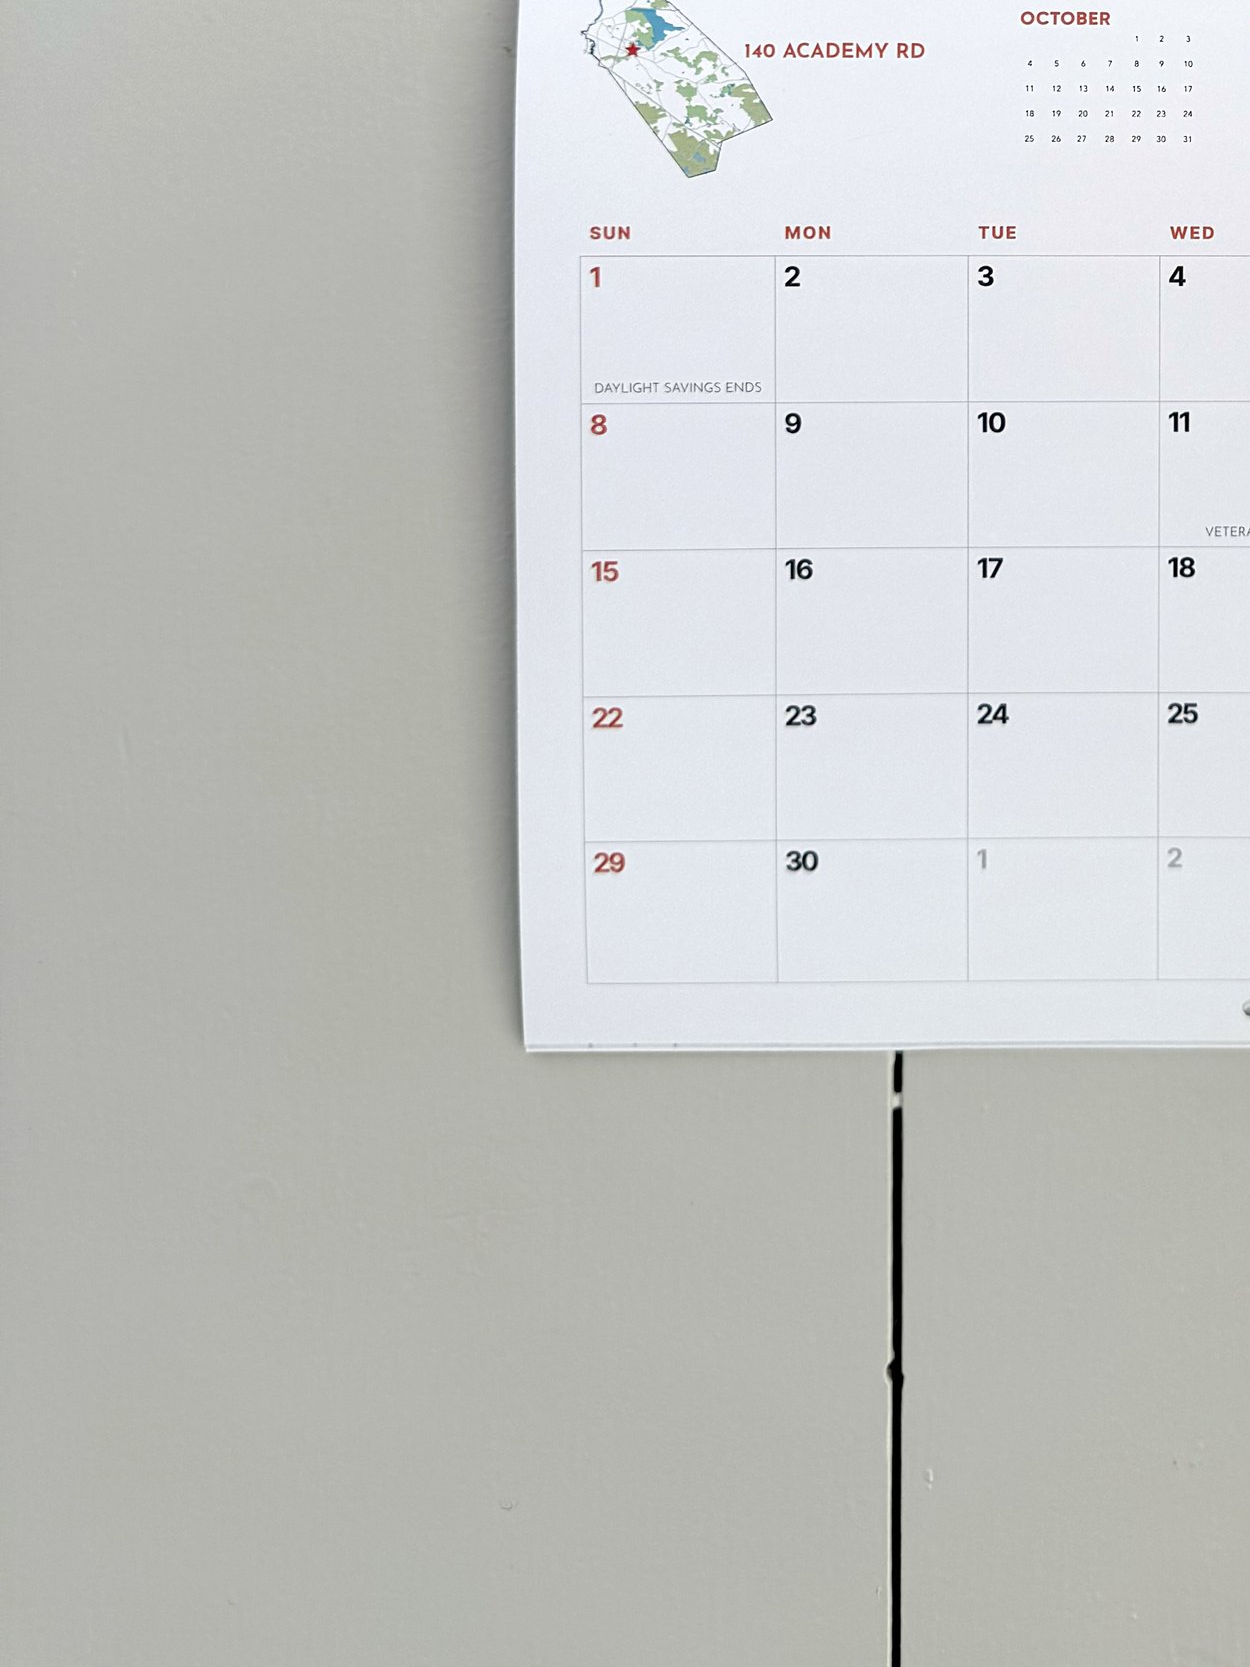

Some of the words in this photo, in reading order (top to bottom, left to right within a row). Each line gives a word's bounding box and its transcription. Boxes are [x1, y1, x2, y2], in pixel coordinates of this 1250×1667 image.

[1020, 10, 1111, 26] OCTOBER
[1159, 34, 1165, 43] 2
[1185, 35, 1191, 43] 3
[744, 43, 776, 59] 140
[782, 41, 890, 59] ACADEMY
[896, 42, 926, 59] RD
[1027, 59, 1033, 67] 4
[1054, 59, 1060, 68] 5
[1080, 59, 1087, 68] 6
[1107, 59, 1113, 68] 7
[1133, 59, 1140, 68] 8
[1158, 60, 1165, 68] 9
[1184, 60, 1194, 68] 10
[1025, 84, 1034, 93] 11
[1052, 84, 1062, 93] 12
[1079, 84, 1089, 93] 13
[1105, 85, 1115, 93] 14
[1132, 85, 1142, 93] 15
[1157, 85, 1167, 93] 16
[1184, 84, 1193, 93] 17
[1025, 109, 1035, 118] 18
[1051, 109, 1062, 118] 19
[1078, 109, 1089, 118] 20
[1104, 109, 1114, 118] 21
[1131, 109, 1142, 118] 22
[1156, 109, 1167, 118] 23
[1182, 109, 1193, 118] 24
[1024, 134, 1035, 143] 25
[1051, 134, 1062, 143] 26
[1076, 134, 1087, 143] 27
[1104, 134, 1115, 143] 28
[1131, 134, 1142, 143] 29
[1156, 134, 1167, 143] 30
[1182, 135, 1192, 143] 31
[589, 225, 631, 241] SUN
[784, 225, 831, 240] MON
[977, 225, 1017, 240] TUE
[1169, 225, 1215, 240] WED
[589, 266, 601, 288] 1
[784, 265, 801, 288] 2
[977, 264, 995, 288] 3
[1168, 265, 1187, 287] 4
[594, 381, 660, 394] DAYLIGHT
[663, 381, 722, 394] SAVINGS
[725, 381, 763, 394] ENDS
[590, 413, 608, 436] 8
[784, 412, 803, 435] 9
[977, 411, 1007, 434] 10
[1168, 410, 1191, 433] 11
[590, 560, 620, 583] 15
[784, 557, 814, 581] 16
[976, 557, 1004, 580] 17
[1167, 556, 1196, 579] 18
[591, 706, 624, 730] 22
[784, 704, 818, 728] 23
[976, 702, 1010, 726] 24
[1167, 702, 1199, 725] 25
[593, 851, 626, 875] 29
[785, 849, 820, 873] 30
[976, 848, 987, 870] 1
[1167, 847, 1183, 869] 2
